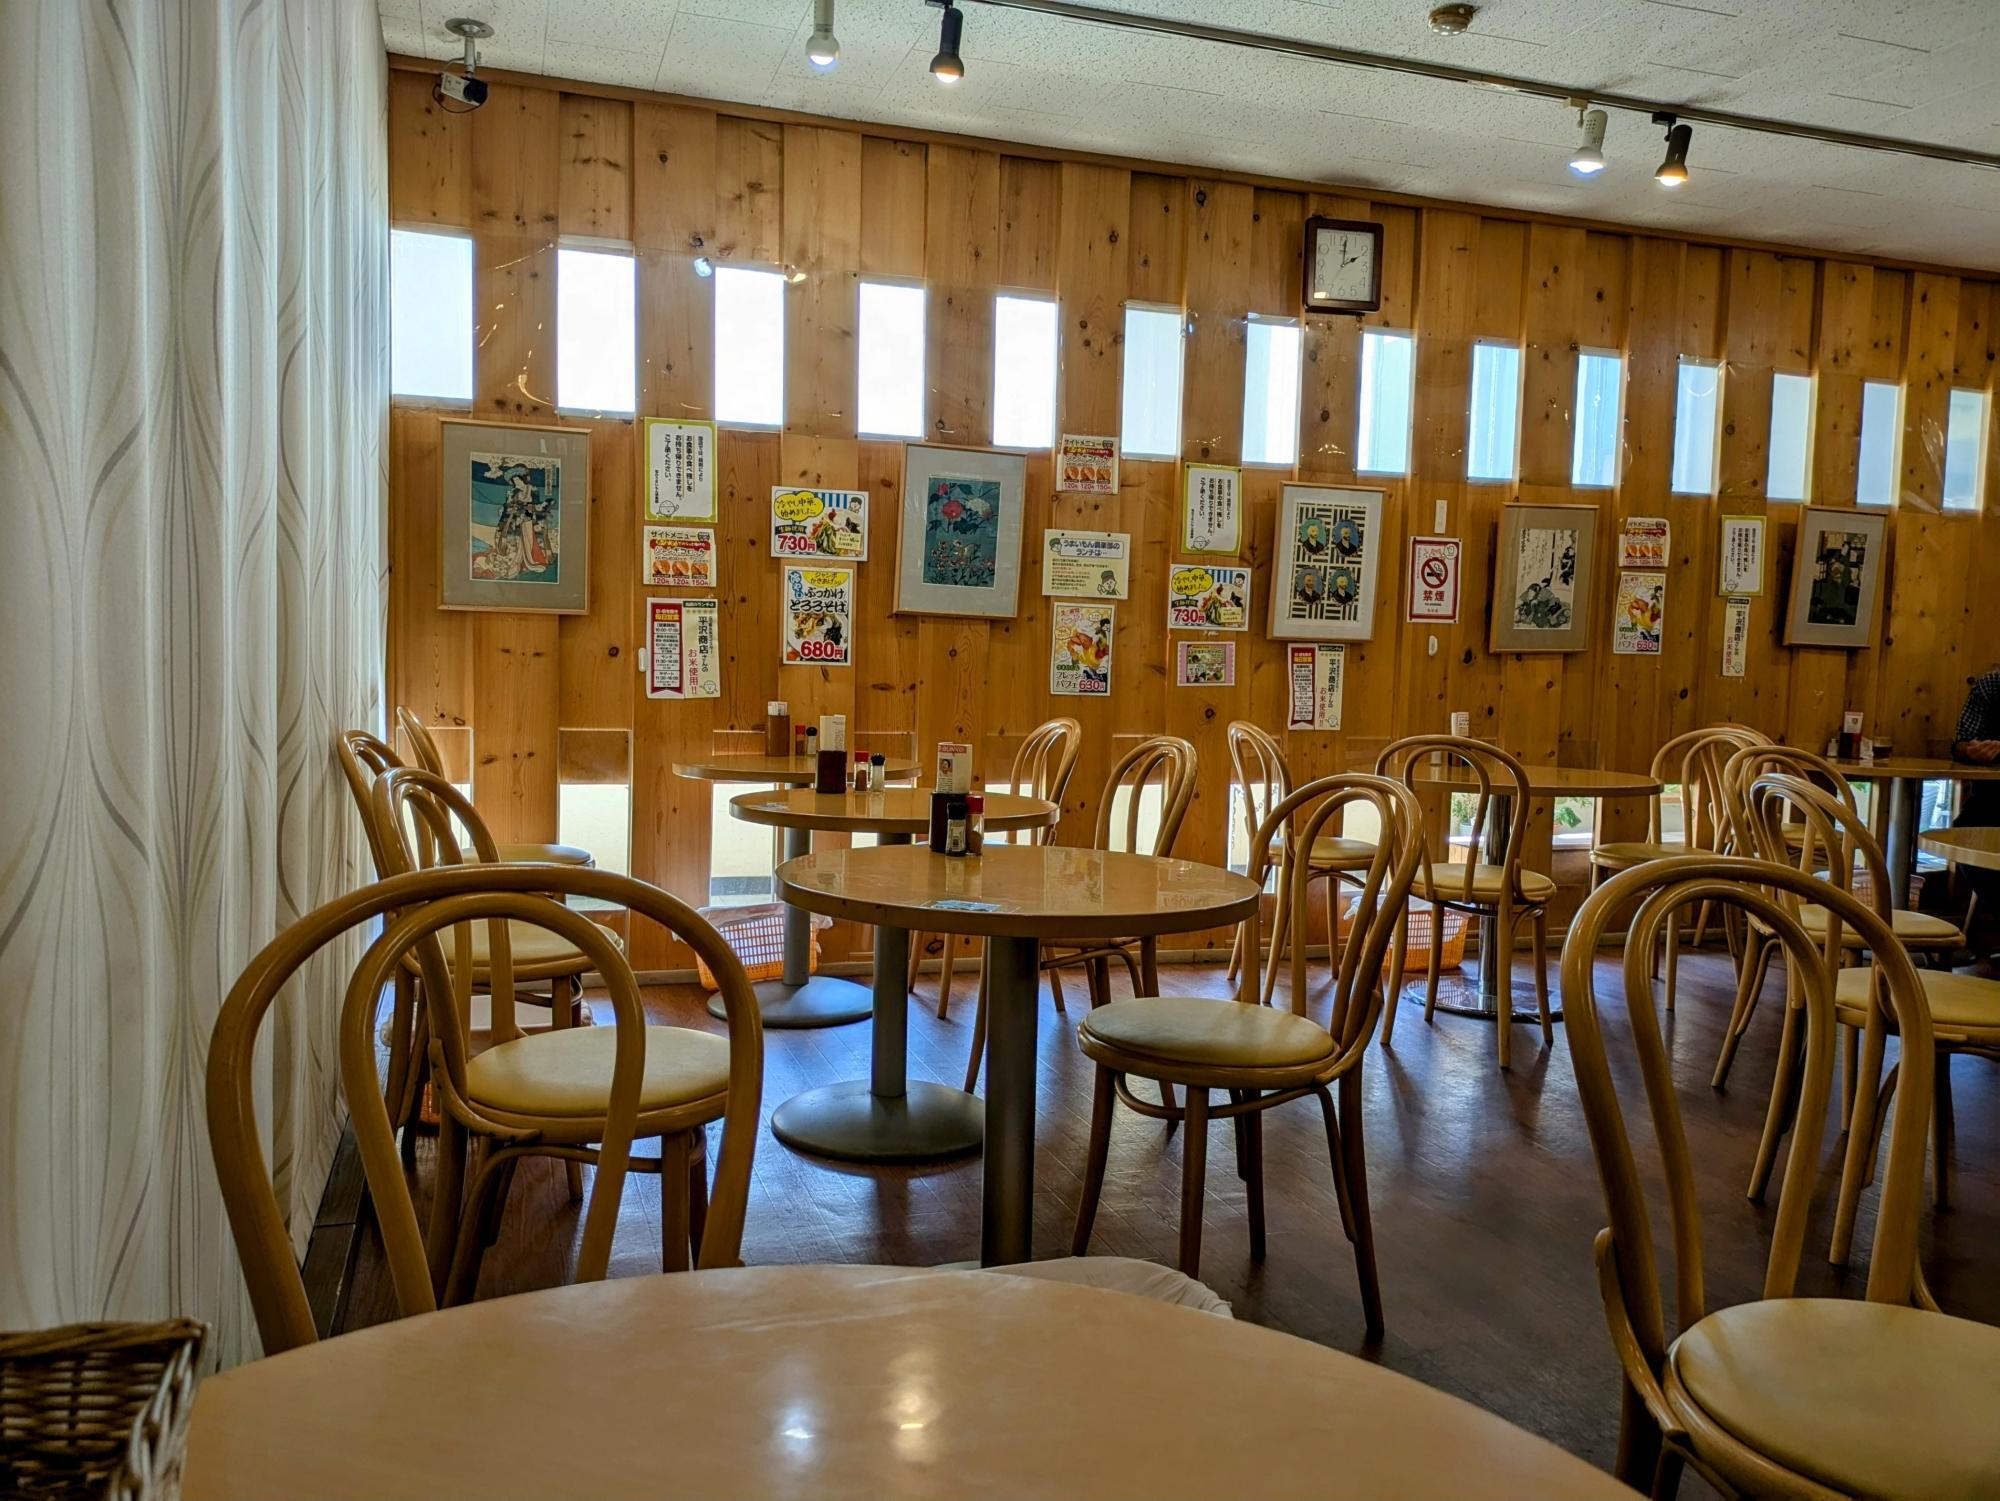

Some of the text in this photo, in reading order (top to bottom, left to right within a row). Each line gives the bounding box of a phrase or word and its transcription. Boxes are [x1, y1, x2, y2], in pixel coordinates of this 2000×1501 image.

[778, 535, 815, 551] 730円
[804, 587, 845, 599] ぶっかけ
[1423, 590, 1445, 602] 禁煙
[790, 600, 848, 613] とろろそば
[1174, 608, 1206, 622] 730円
[698, 616, 709, 673] 平沢商店さんの
[801, 641, 844, 658] 680円
